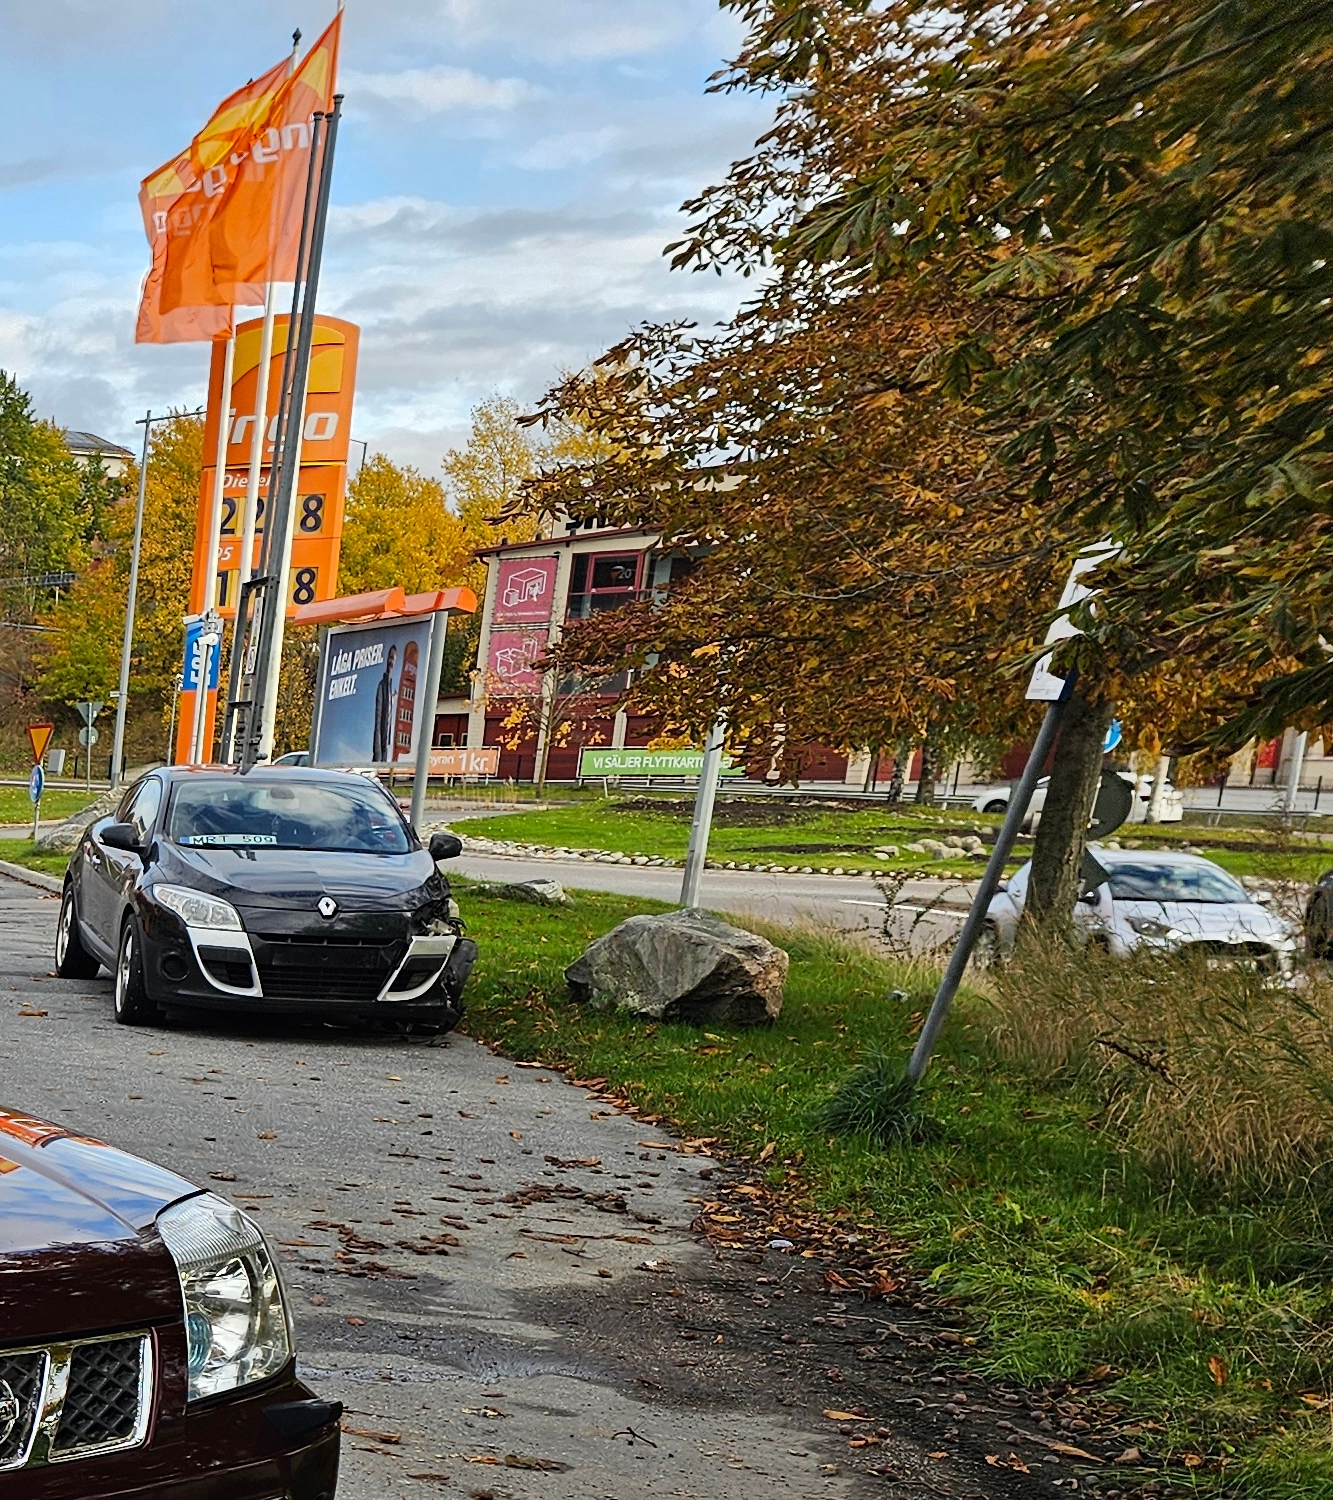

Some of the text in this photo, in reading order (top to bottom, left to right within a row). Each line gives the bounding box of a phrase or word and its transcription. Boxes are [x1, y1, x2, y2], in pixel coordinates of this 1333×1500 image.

[223, 474, 272, 488] Dieel
[331, 648, 352, 676] LÅGA
[352, 643, 383, 670] PRISER.
[329, 674, 357, 700] ENKELT.
[593, 757, 603, 769] VI
[604, 754, 641, 769] SÄLJER
